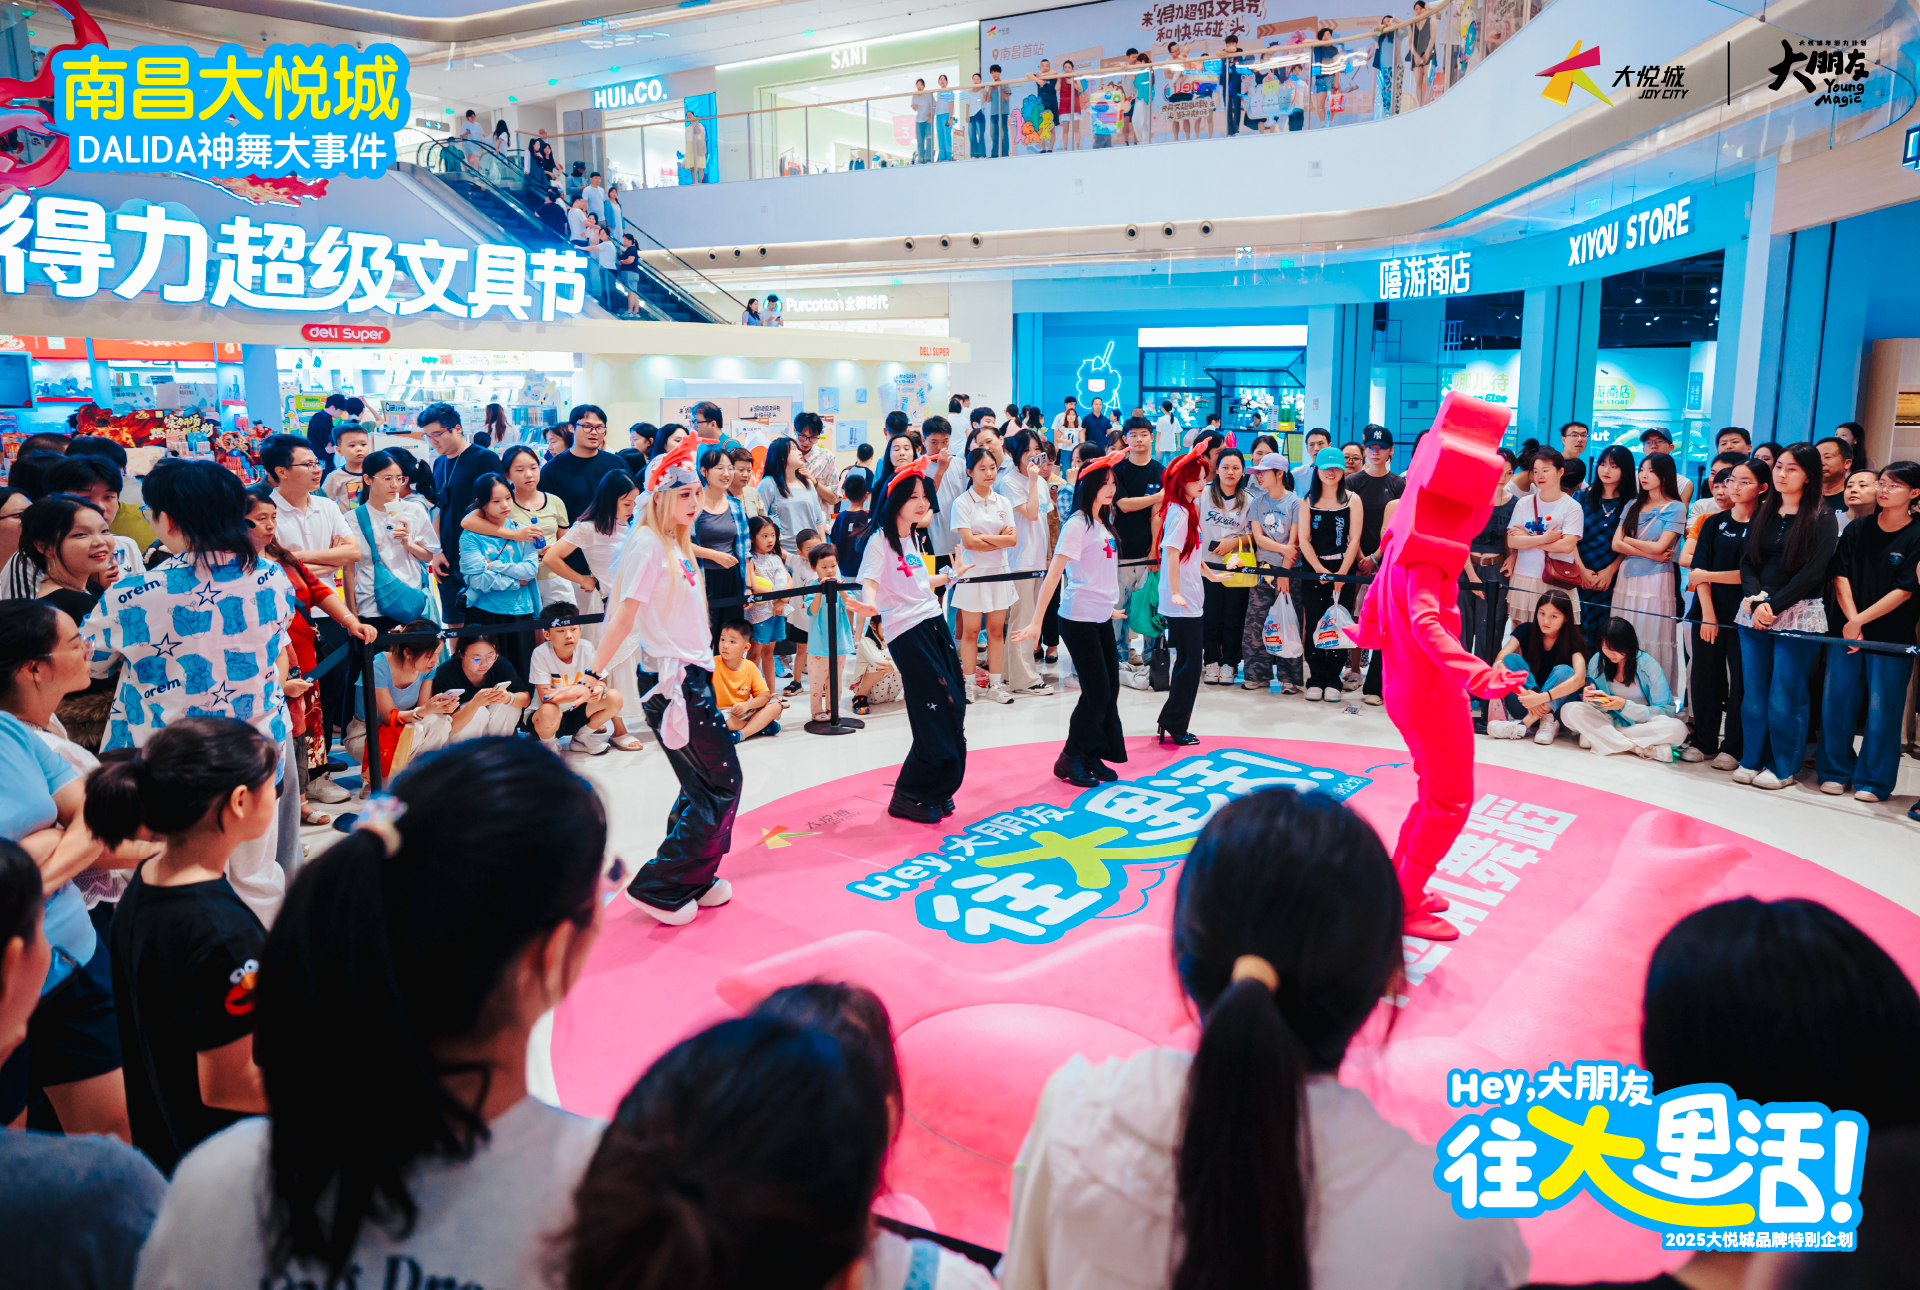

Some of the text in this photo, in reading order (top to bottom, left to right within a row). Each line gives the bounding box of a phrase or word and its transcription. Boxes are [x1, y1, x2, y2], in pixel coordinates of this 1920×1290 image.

[1156, 17, 1246, 42] 和快乐碰头
[831, 45, 867, 70] SANI
[1000, 42, 1044, 61] 南昌首站
[1568, 196, 1692, 267] XIYOU STORE
[0, 195, 588, 322] 得力超级文具节
[1379, 251, 1472, 300] 嘻游商店
[785, 298, 845, 313] Purcotton
[309, 327, 384, 343] deli Super
[919, 347, 950, 357] DELI SUPER
[118, 580, 161, 604] orem
[144, 678, 181, 699] orem
